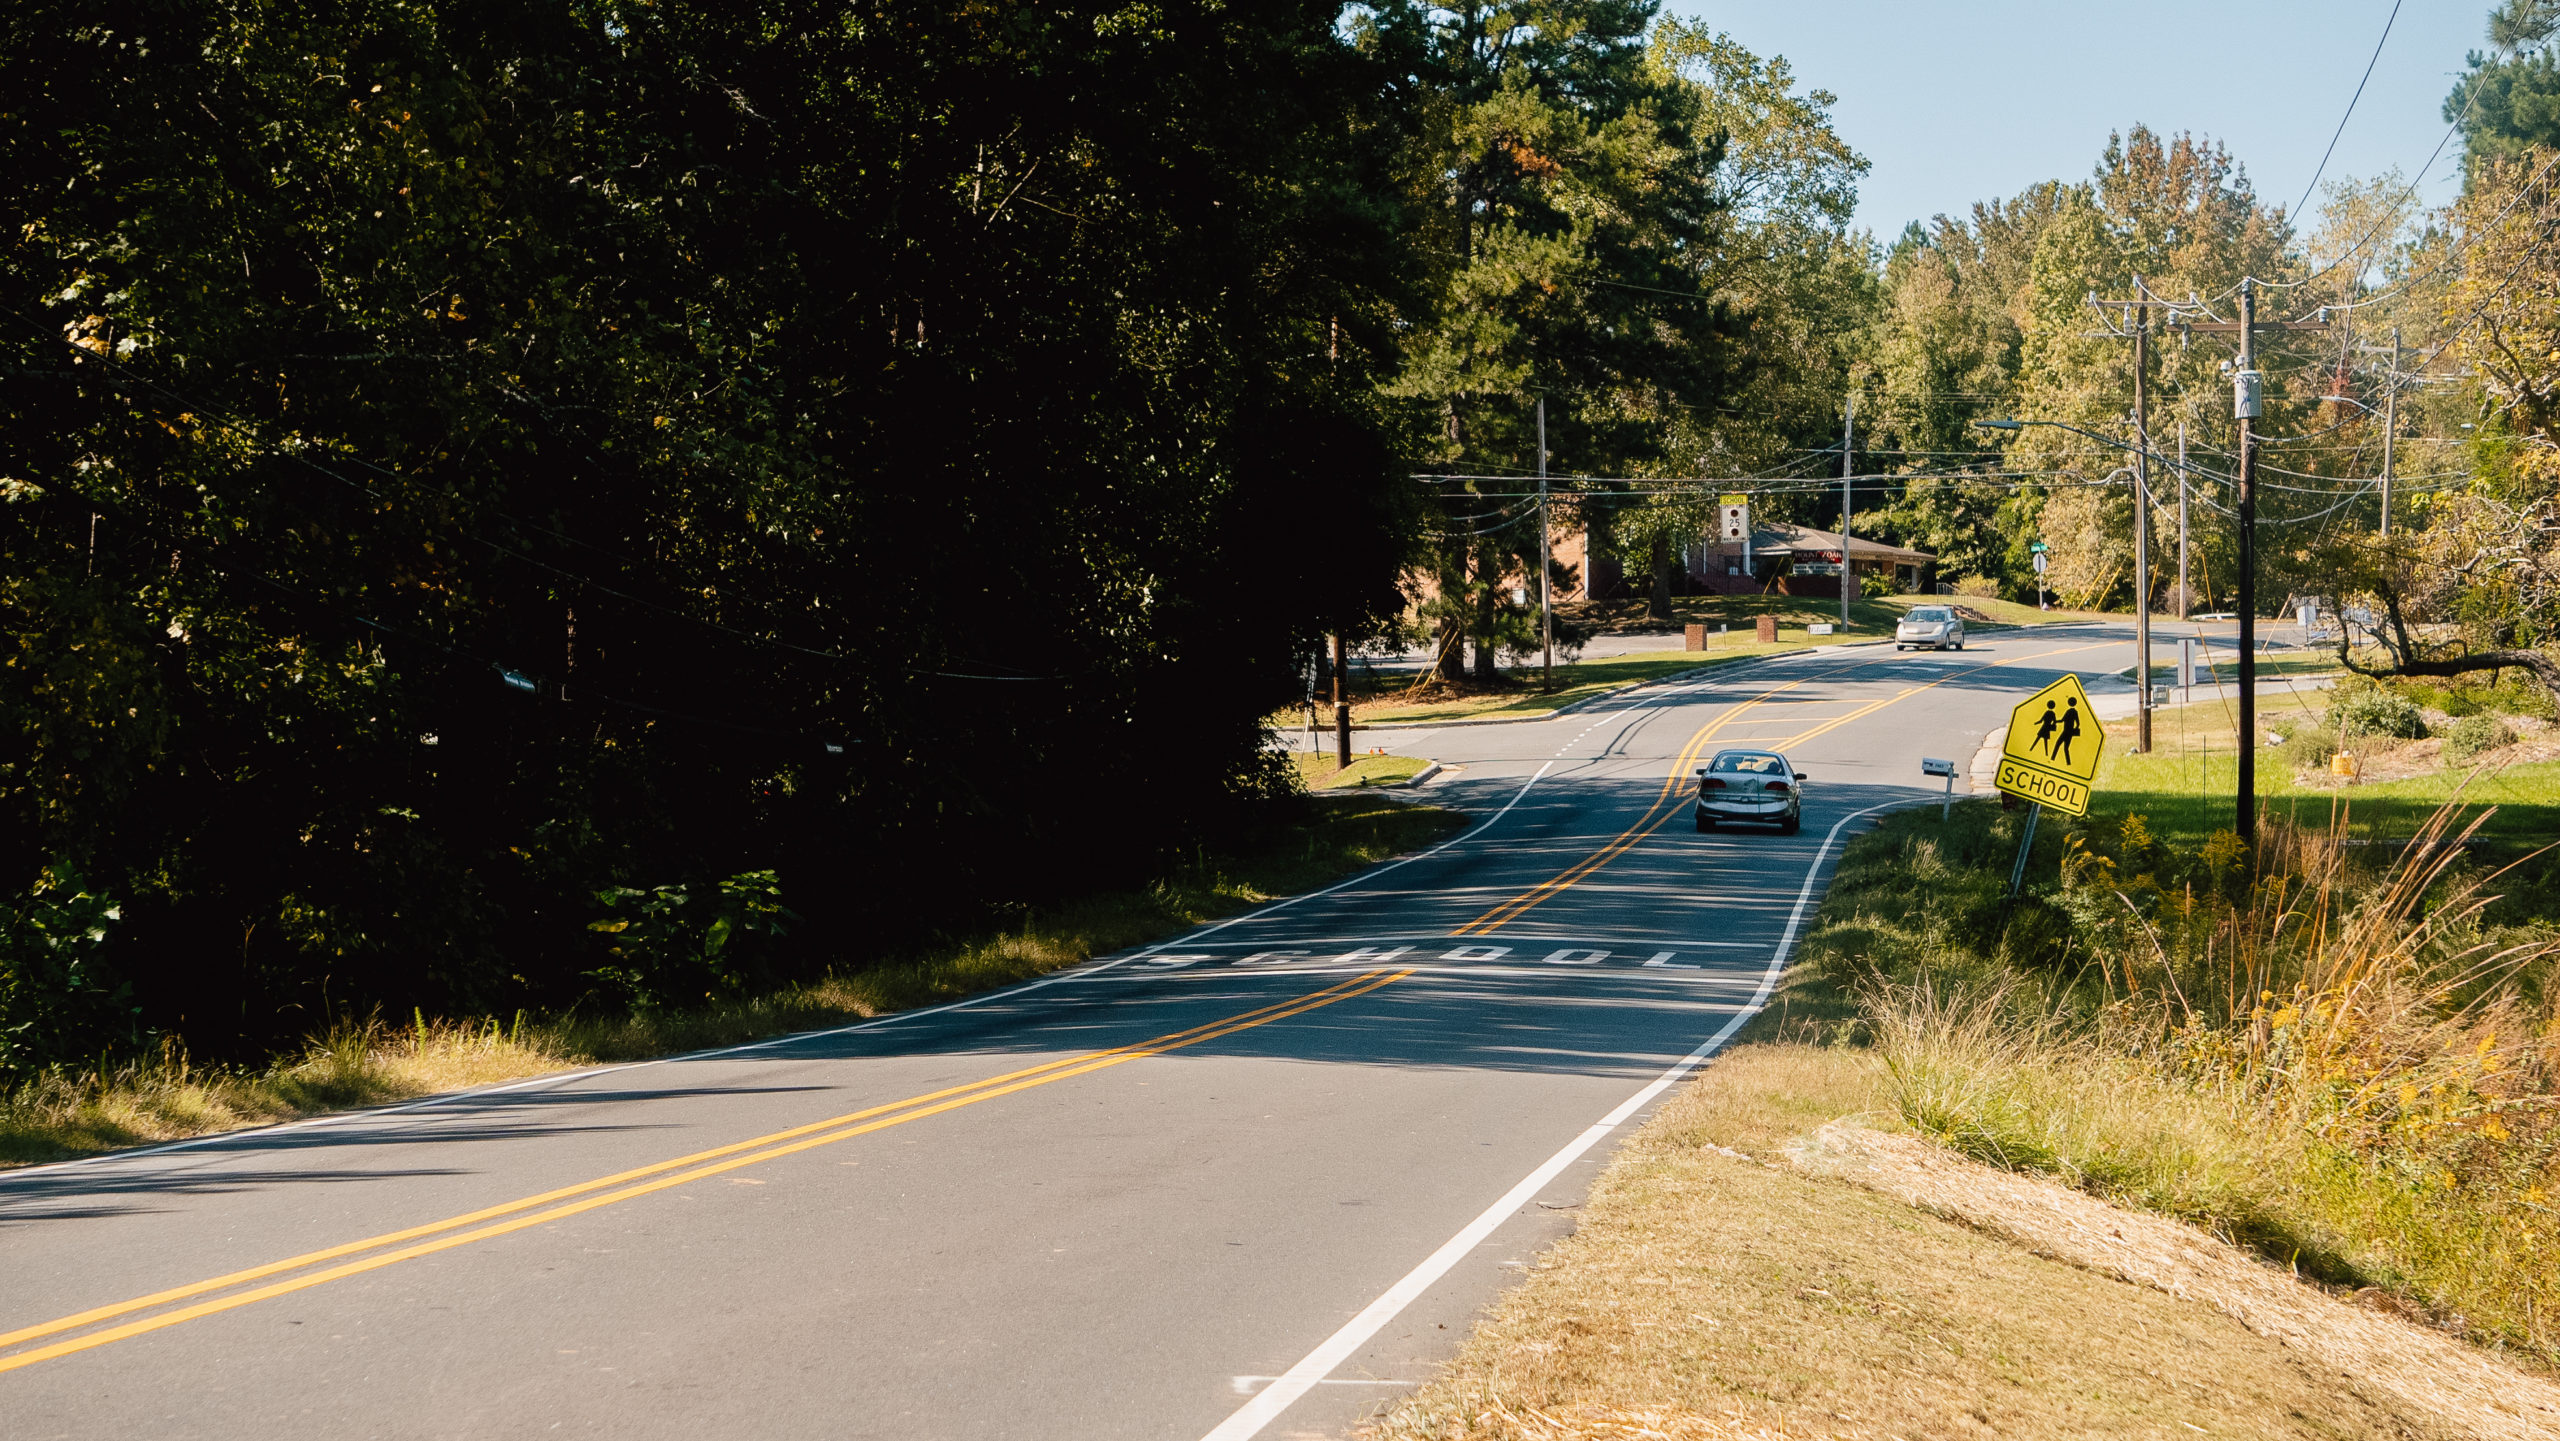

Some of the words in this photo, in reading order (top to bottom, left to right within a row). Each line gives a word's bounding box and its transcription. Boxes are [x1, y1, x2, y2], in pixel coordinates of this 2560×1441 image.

[1722, 496, 1745, 504] SCHOOL
[1729, 518, 1740, 528] 25
[2002, 766, 2080, 807] SCHOOL
[1130, 945, 1701, 970] SCHOOL
